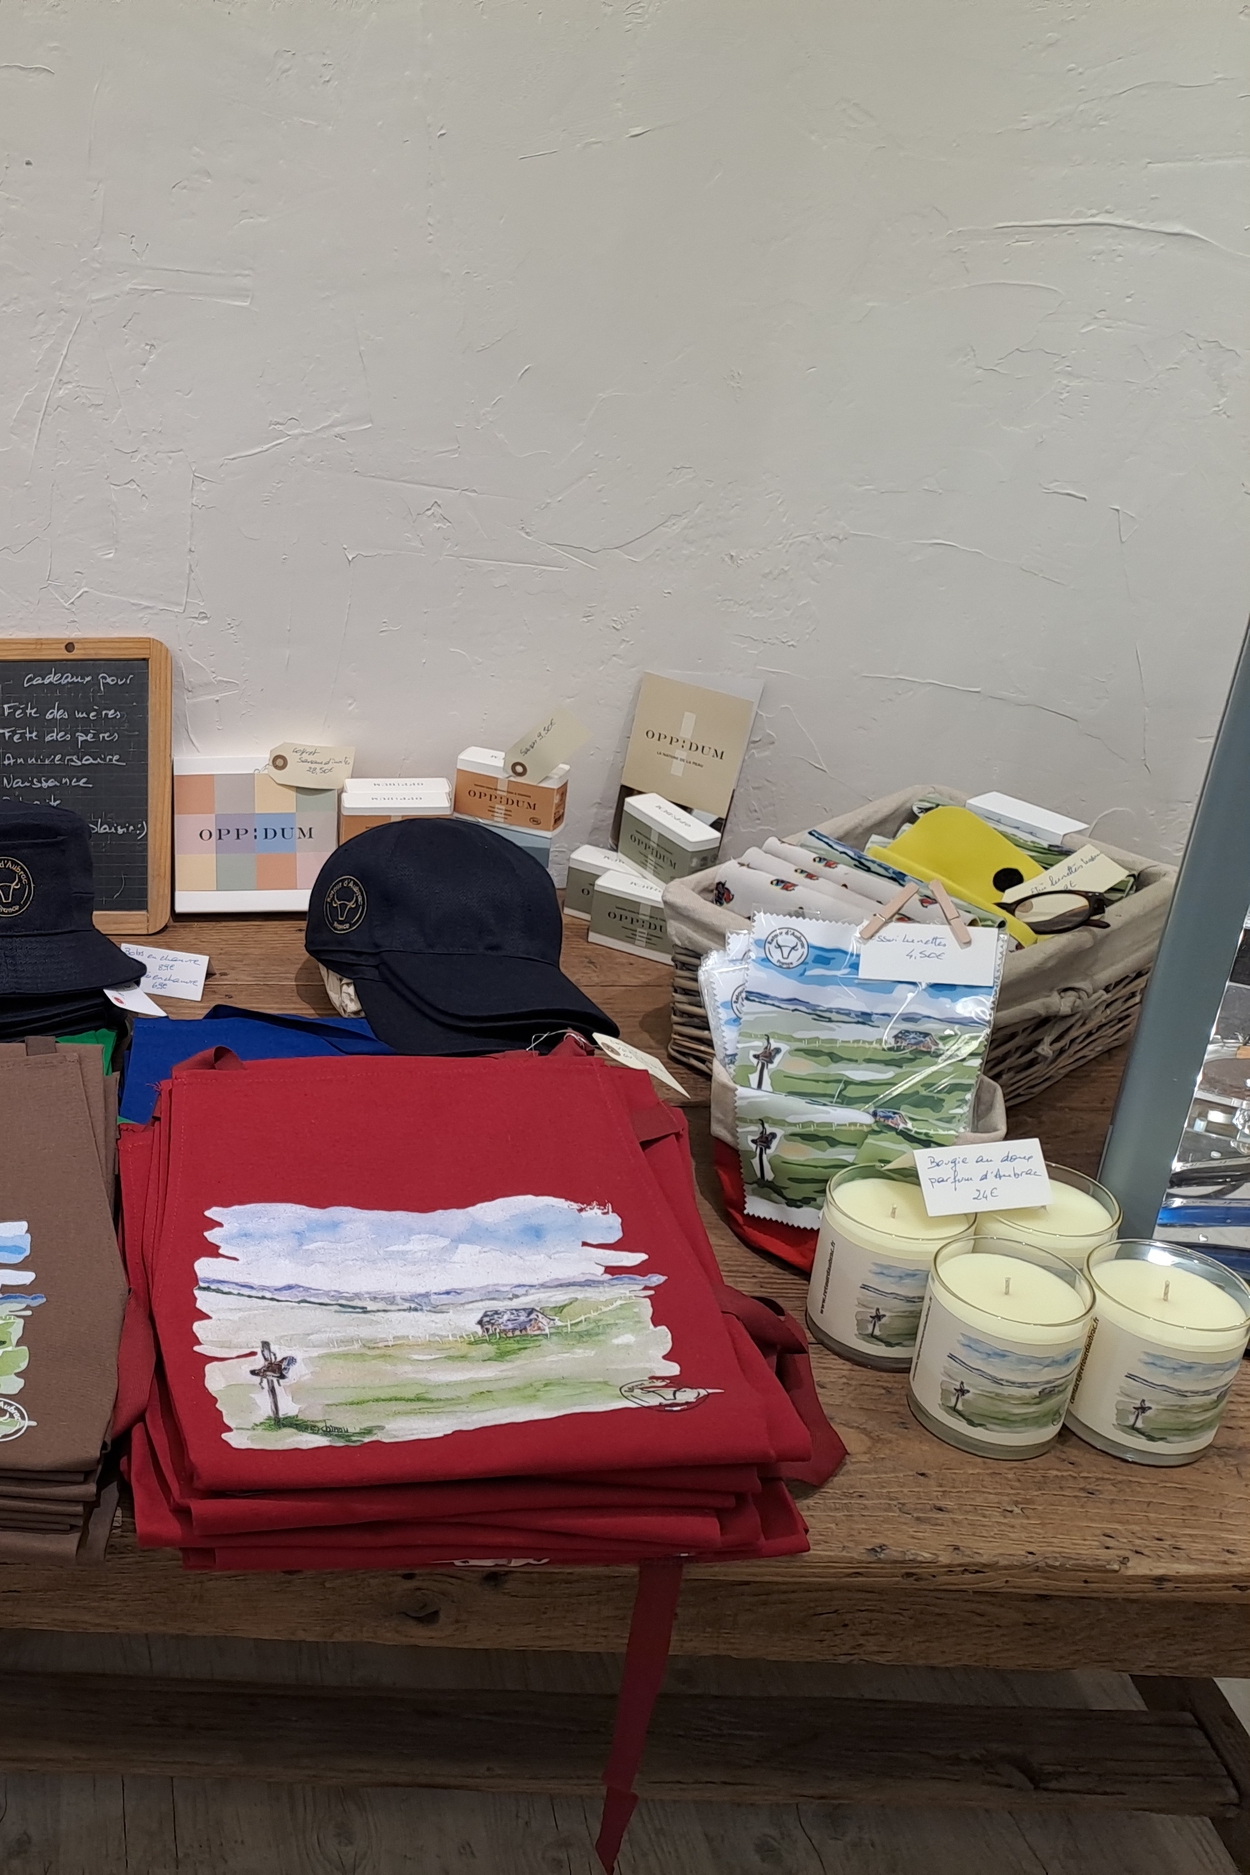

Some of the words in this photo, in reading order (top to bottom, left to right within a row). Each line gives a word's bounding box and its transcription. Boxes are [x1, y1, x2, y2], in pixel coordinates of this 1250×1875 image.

[98, 673, 134, 695] pour
[3, 702, 39, 718] Fête
[46, 702, 68, 719] des
[75, 706, 121, 719] mères
[45, 728, 70, 742] des
[76, 730, 119, 748] pères
[3, 753, 126, 766] Anniversaire
[3, 774, 93, 788] Naissance
[927, 1155, 969, 1174] Bougie
[979, 1166, 1043, 1182] d'Aubrac
[972, 1187, 999, 1201] 24€
